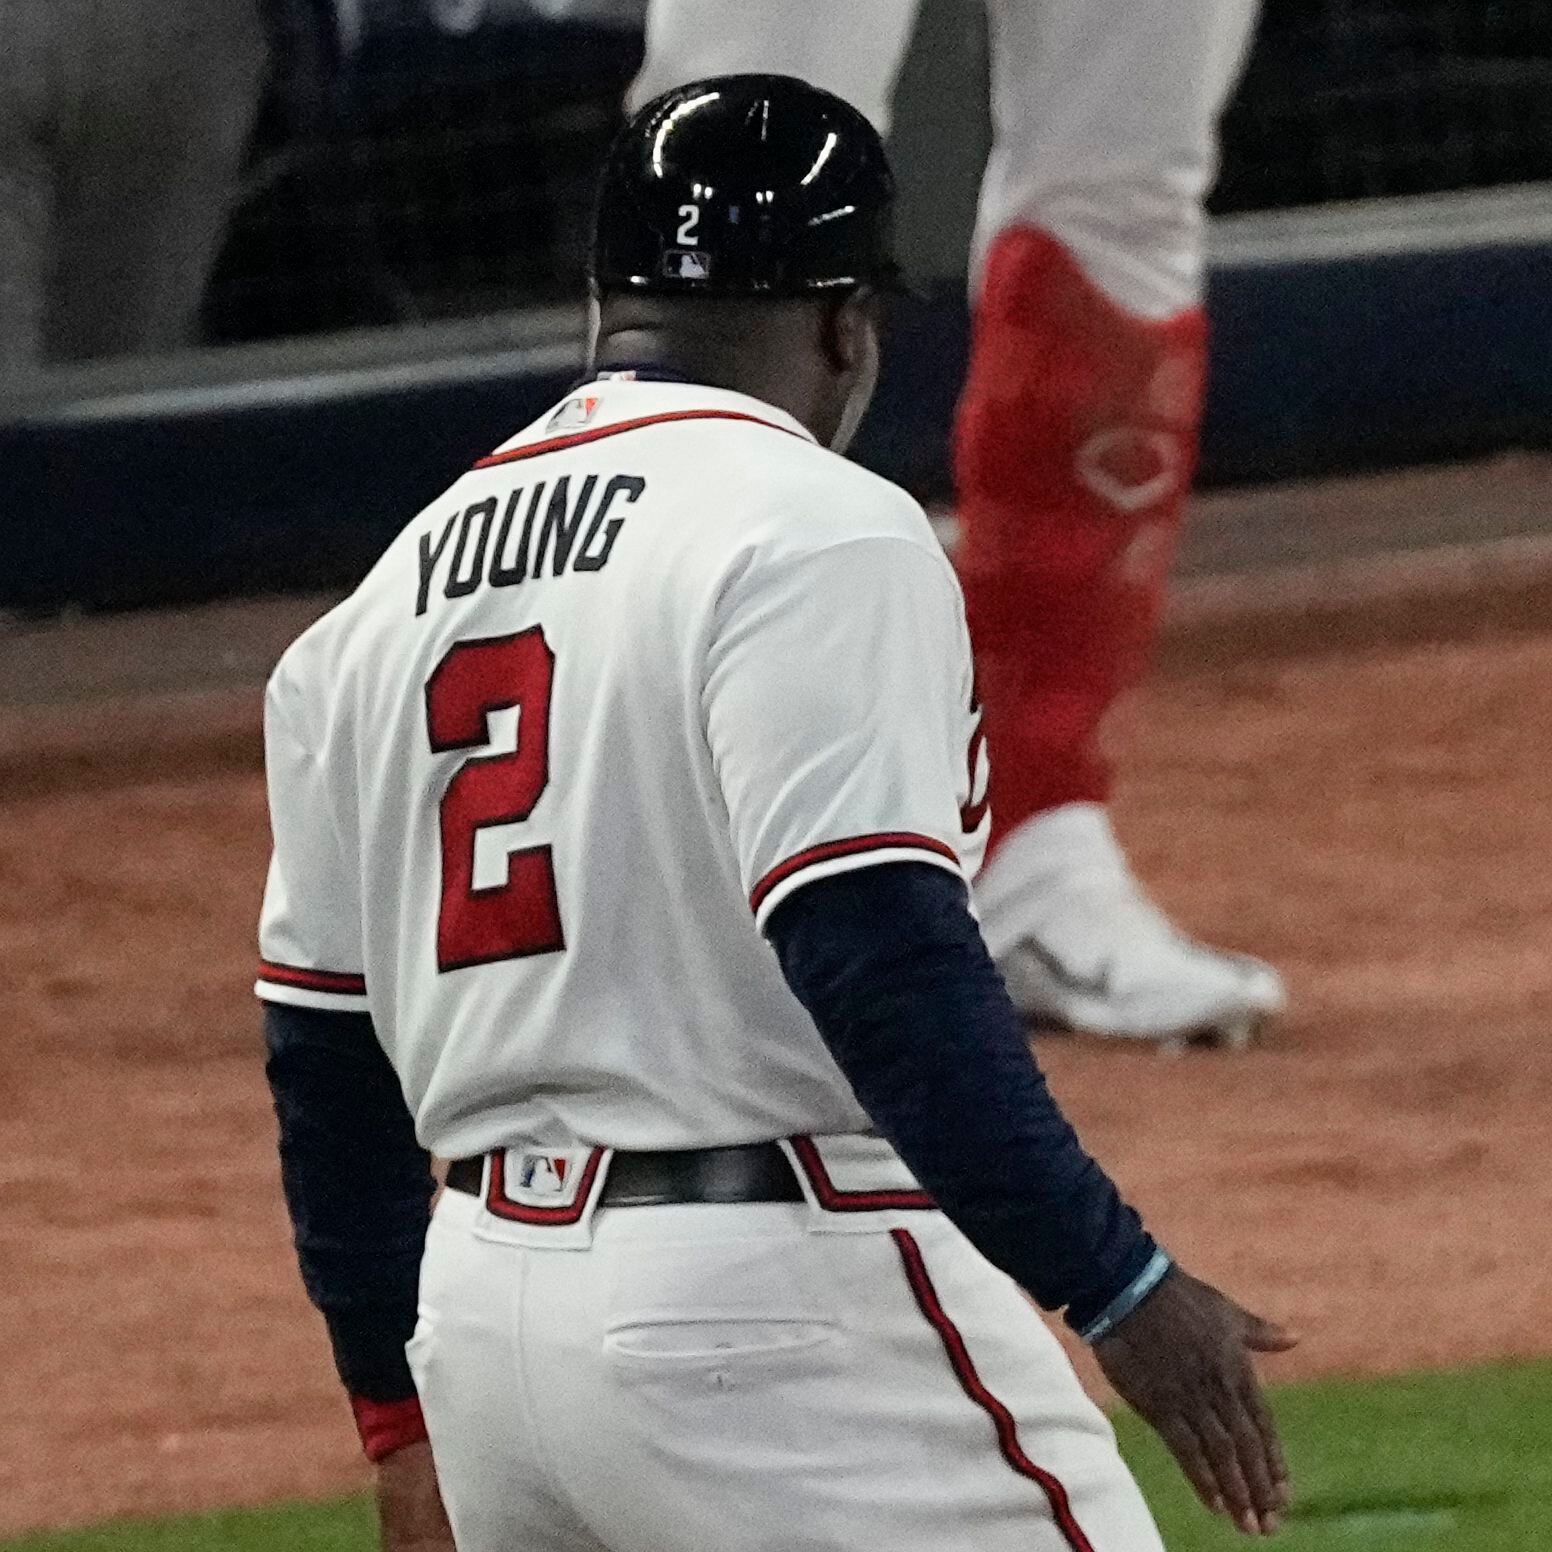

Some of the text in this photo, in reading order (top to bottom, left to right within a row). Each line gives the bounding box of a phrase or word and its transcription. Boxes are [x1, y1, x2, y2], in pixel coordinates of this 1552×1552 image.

[676, 204, 700, 246] 2
[413, 474, 646, 617] YOUNG
[424, 623, 565, 974] 2
